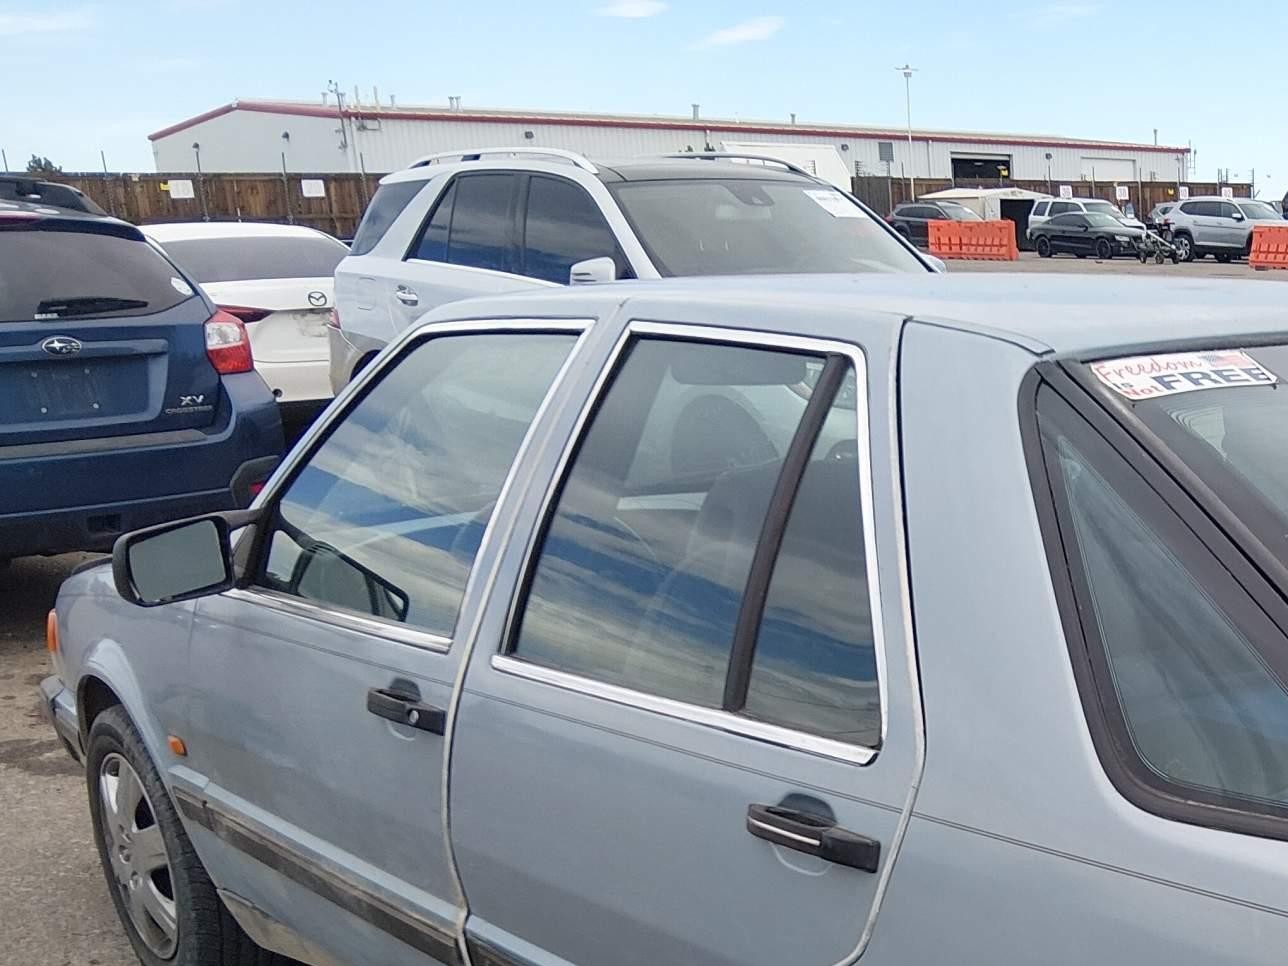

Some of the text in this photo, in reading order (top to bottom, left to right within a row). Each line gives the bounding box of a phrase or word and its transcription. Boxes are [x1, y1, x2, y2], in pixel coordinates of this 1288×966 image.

[1094, 356, 1203, 381] Freedom
[1121, 367, 1271, 397] Not FREE
[180, 395, 204, 405] XV
